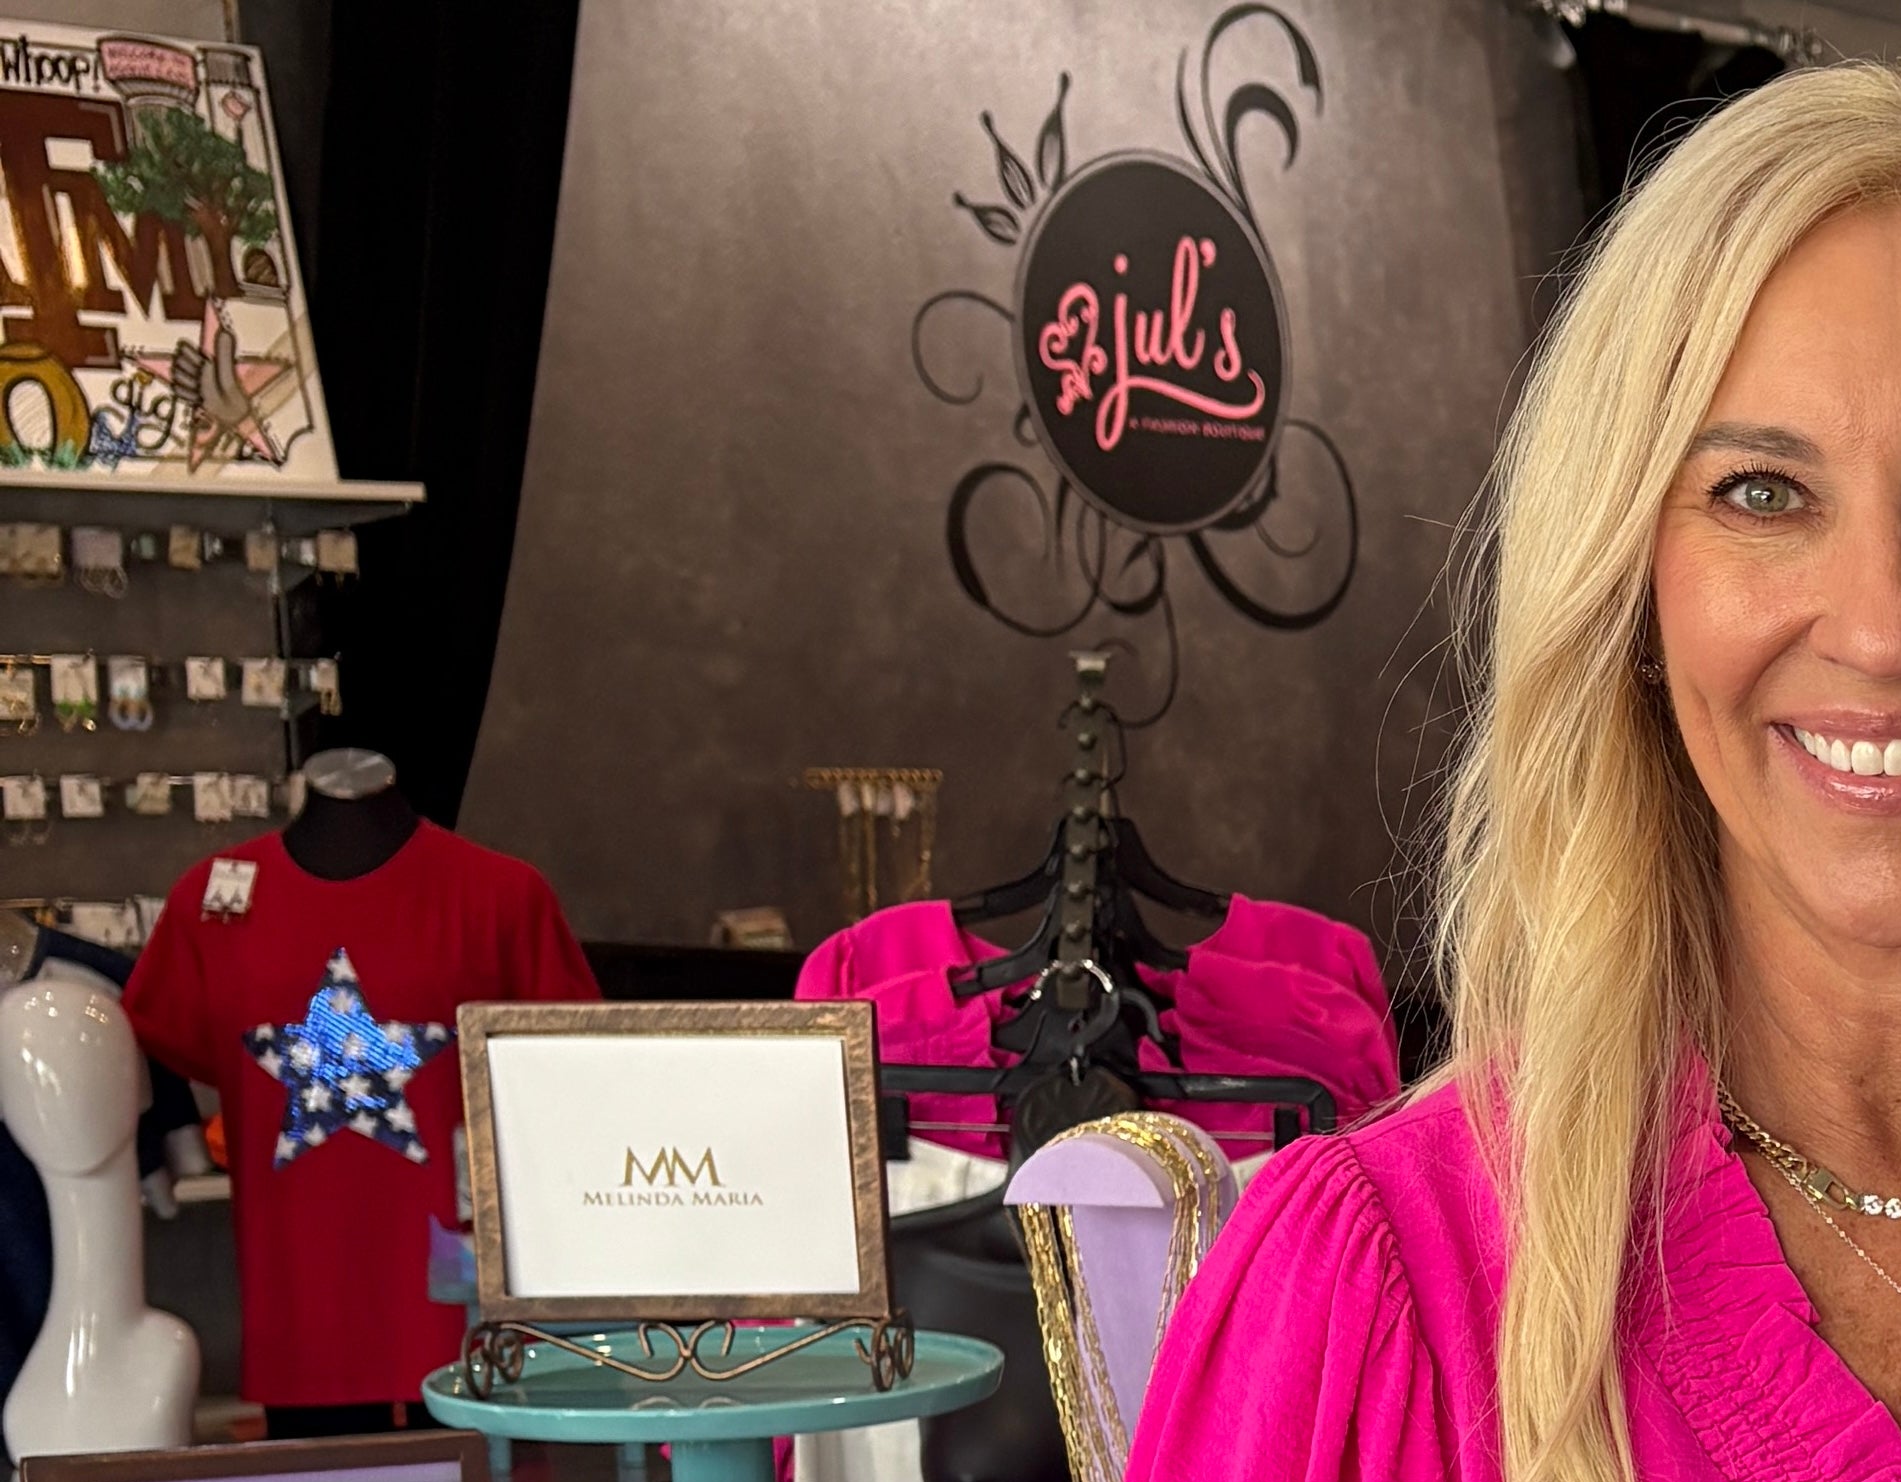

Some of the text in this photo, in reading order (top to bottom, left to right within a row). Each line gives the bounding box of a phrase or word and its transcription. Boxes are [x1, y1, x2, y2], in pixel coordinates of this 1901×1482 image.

[1096, 235, 1265, 451] jul's
[618, 1146, 726, 1188] MM
[583, 1191, 764, 1207] MELINDA MARIA
